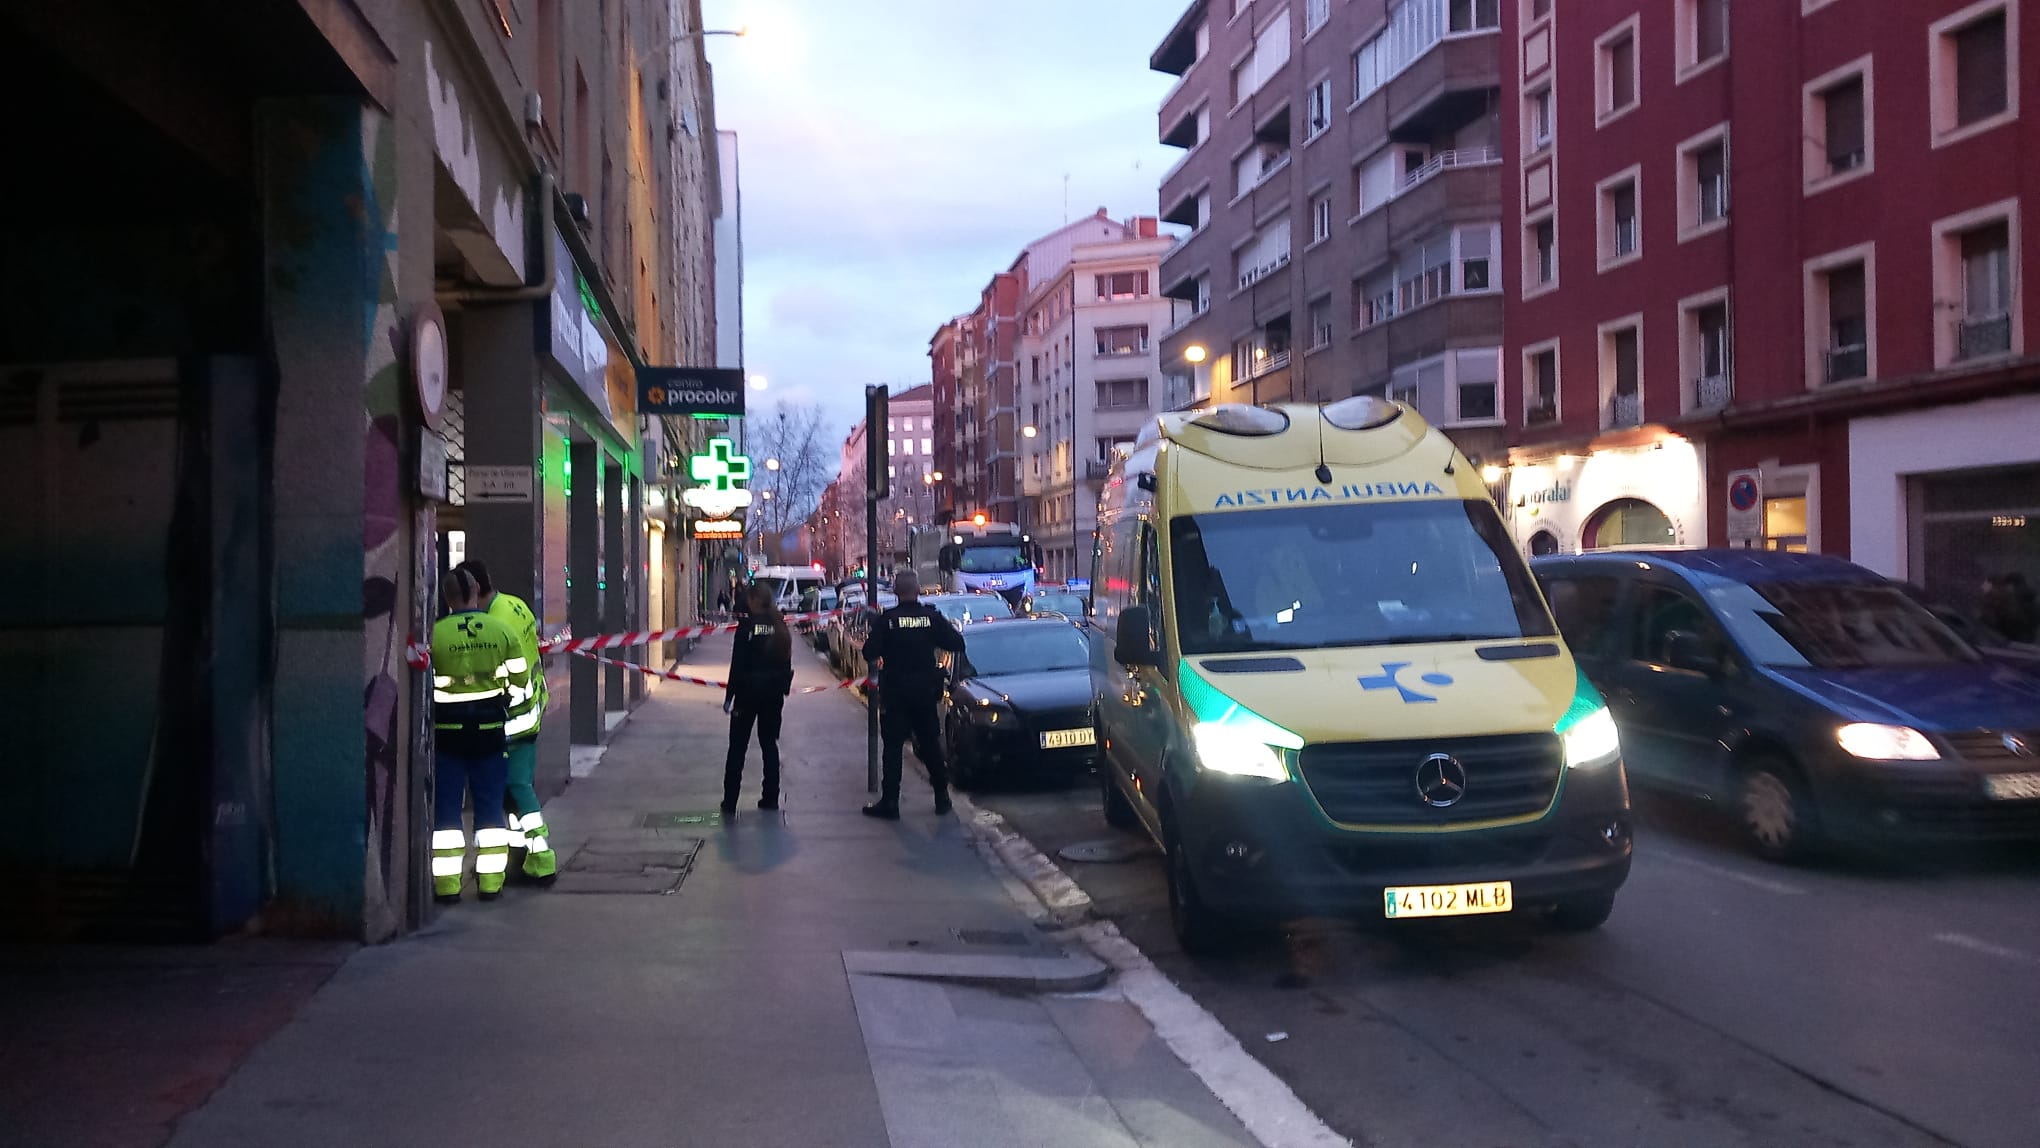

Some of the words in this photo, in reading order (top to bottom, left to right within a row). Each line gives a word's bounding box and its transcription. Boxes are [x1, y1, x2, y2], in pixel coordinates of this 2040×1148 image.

[668, 387, 738, 407] procolor
[1048, 731, 1077, 747] 4910
[1079, 728, 1094, 744] DY
[1402, 891, 1457, 911] 4102
[1466, 887, 1506, 908] MLB
